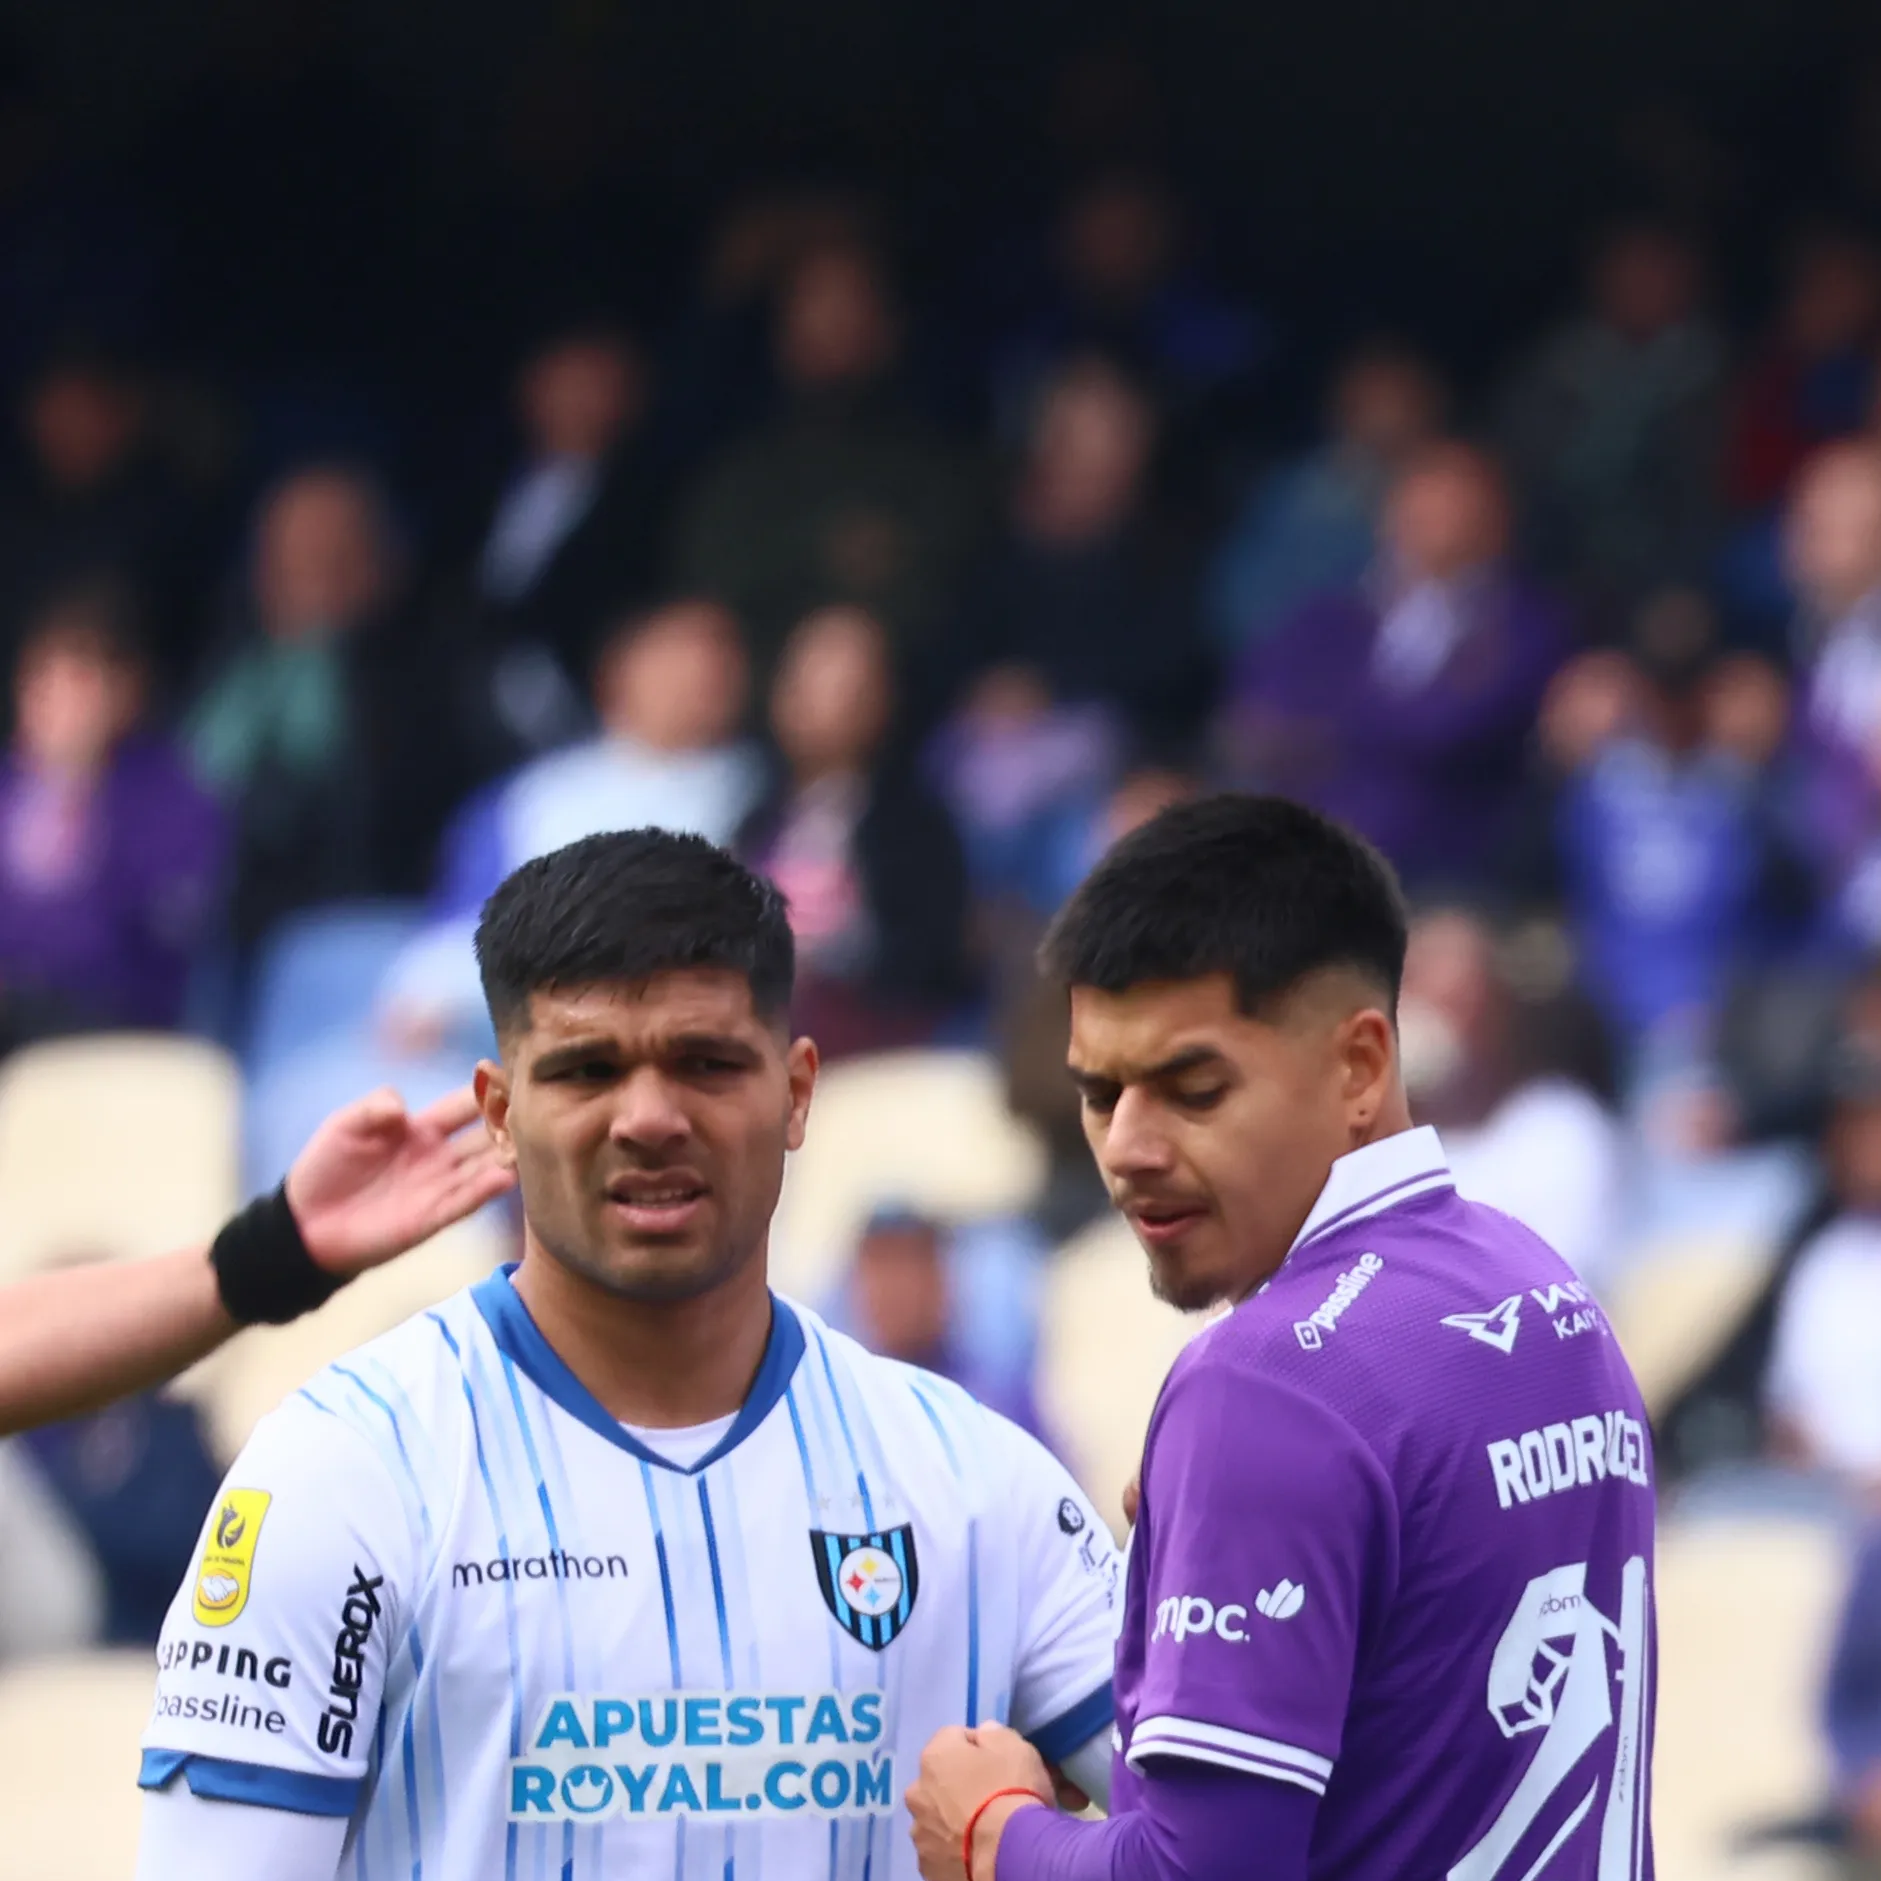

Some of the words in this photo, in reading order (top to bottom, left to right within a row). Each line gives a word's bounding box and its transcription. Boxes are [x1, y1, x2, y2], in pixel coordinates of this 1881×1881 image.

[1309, 1251, 1383, 1331] passline
[452, 1550, 629, 1588] marathon
[317, 1562, 384, 1759] SUEROX
[535, 1693, 882, 1750] APUESTAS
[509, 1758, 892, 1814] ROYAL.COM
